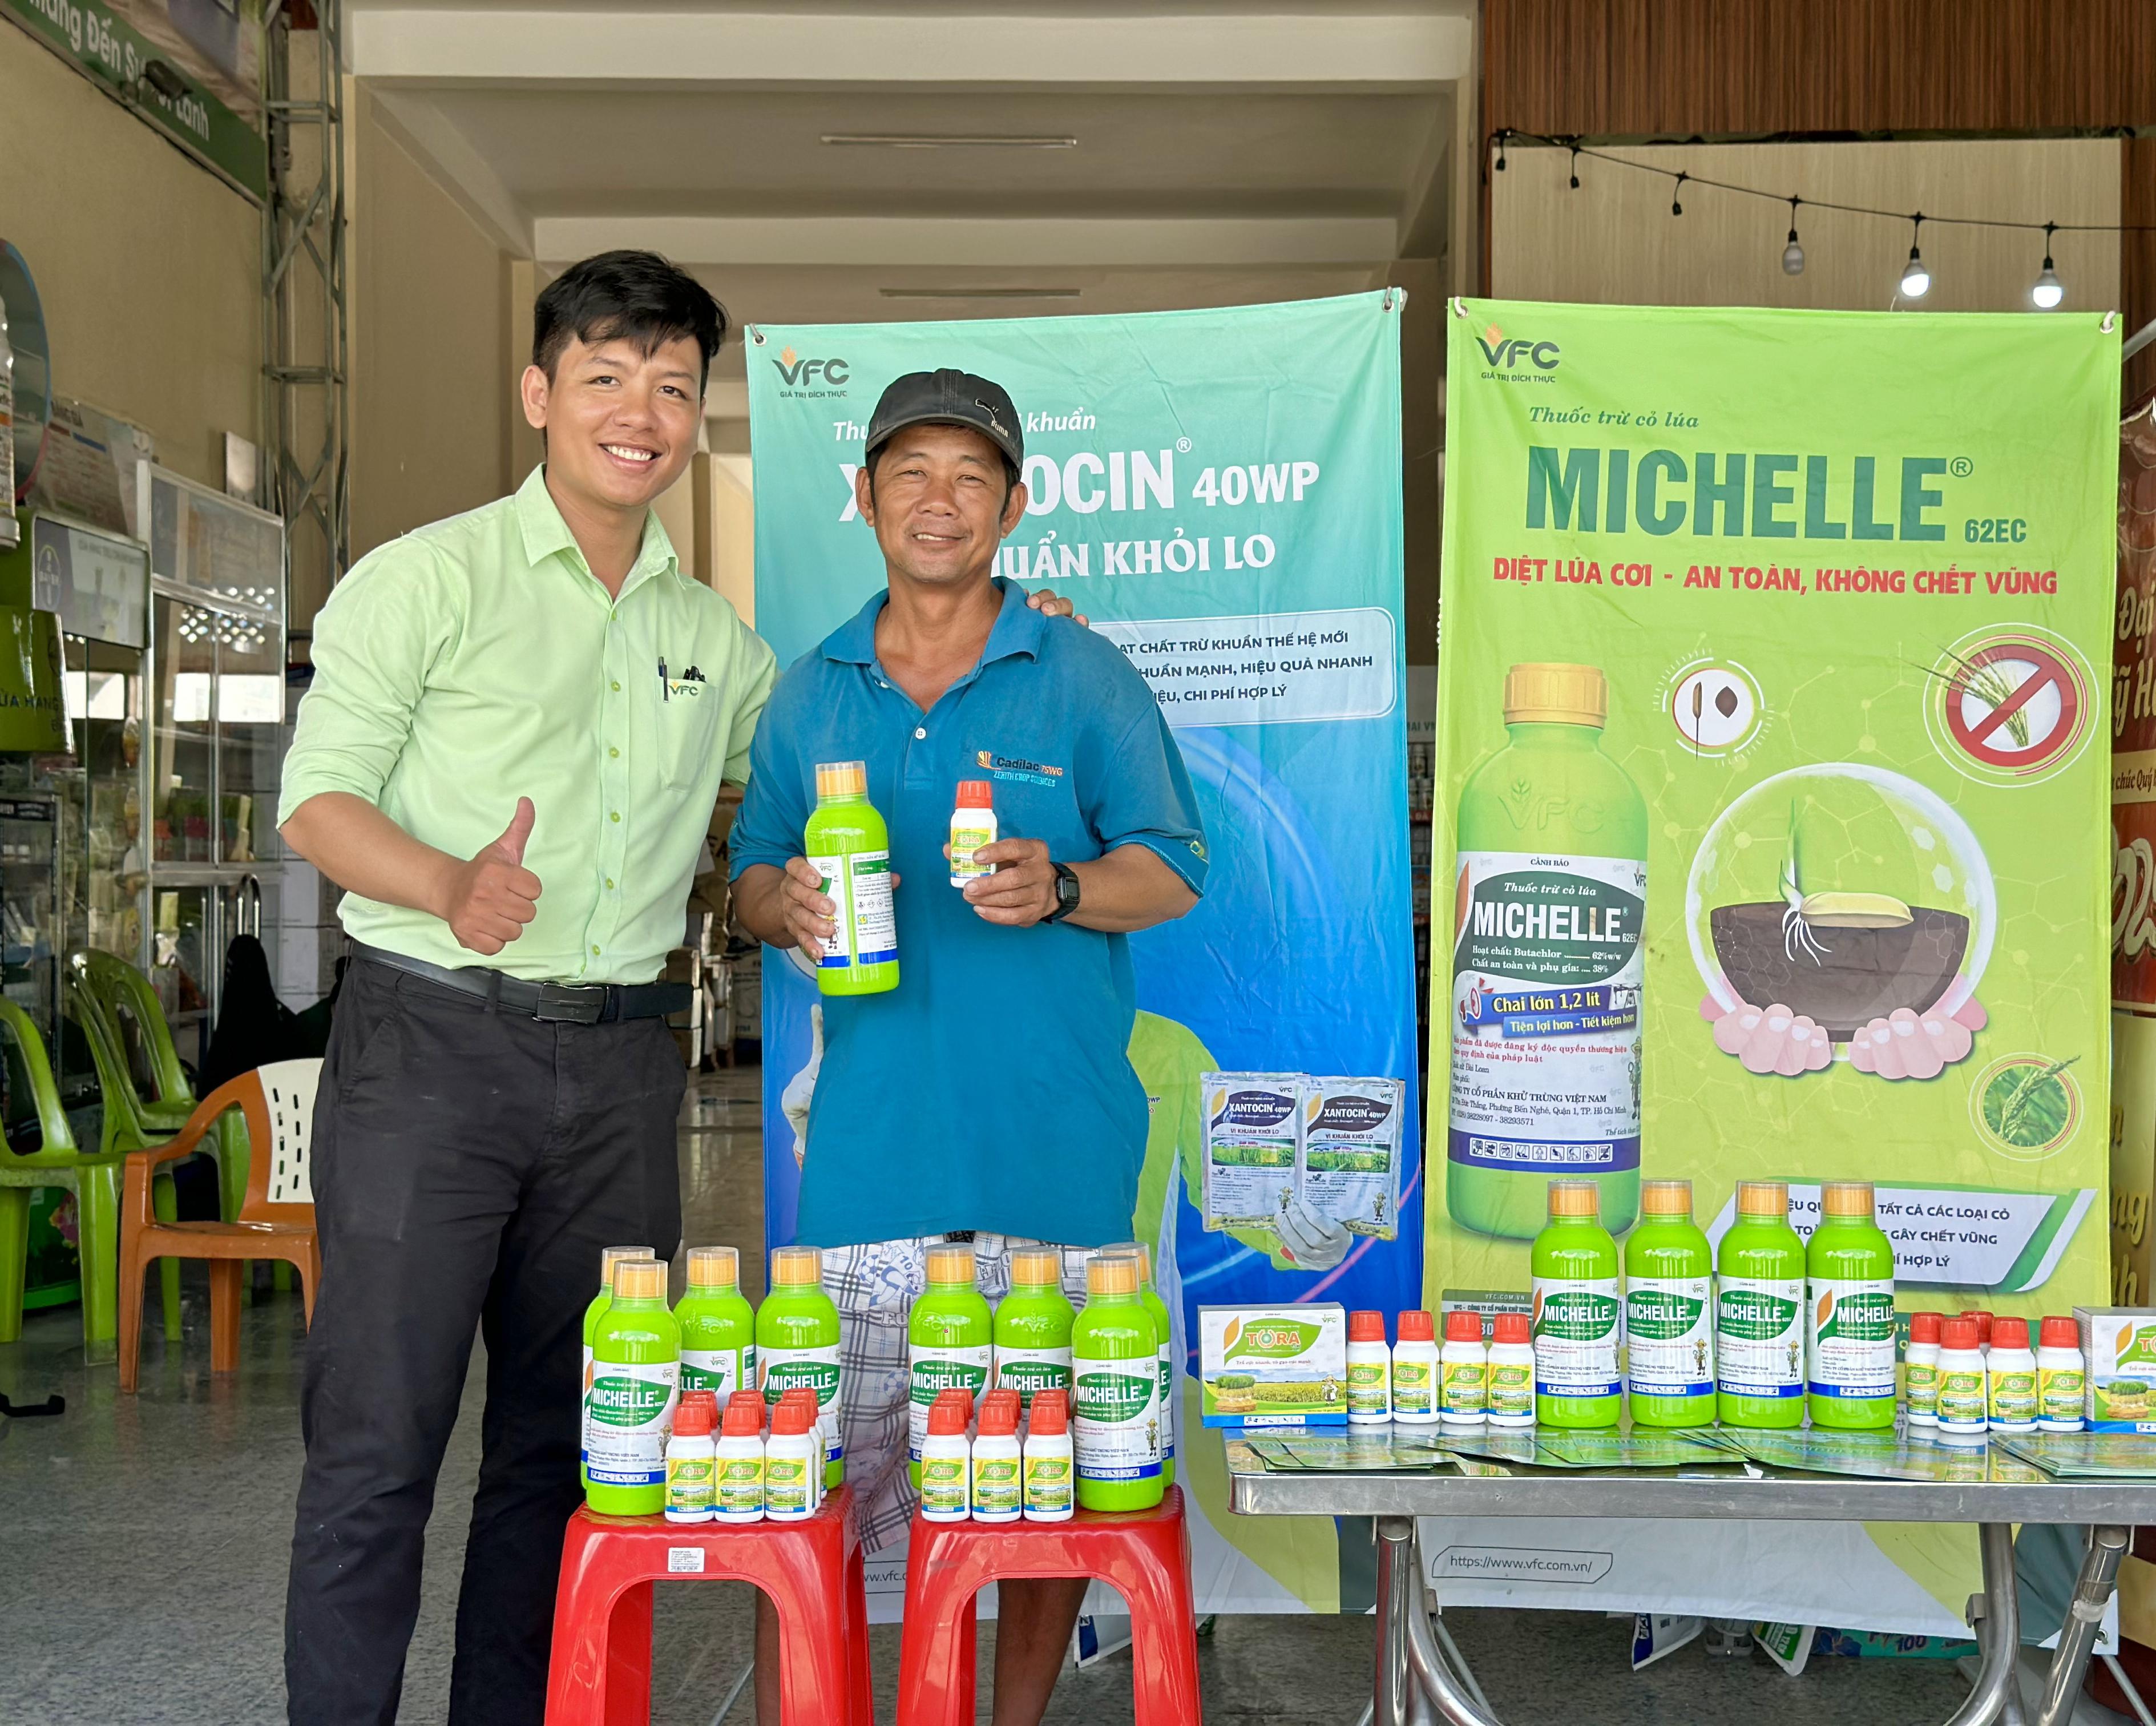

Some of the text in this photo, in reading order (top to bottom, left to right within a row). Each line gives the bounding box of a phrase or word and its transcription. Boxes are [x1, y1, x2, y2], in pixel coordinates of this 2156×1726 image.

[1475, 336, 1560, 370] VFC
[772, 359, 850, 386] VFC
[1497, 374, 1509, 382] TRỊ
[1511, 373, 1531, 382] ĐÍCH
[1533, 374, 1556, 384] THỰC
[827, 390, 847, 398] THỰC
[1026, 406, 1096, 433] khuẩn
[1529, 406, 1699, 428] Thuốc trừ cỏ lúa
[1192, 461, 1320, 507] 40WP
[1964, 518, 2027, 543] 62EC
[1103, 527, 1210, 576] KHỎI
[1224, 533, 1277, 570] LO
[1493, 554, 1548, 586] DIỆT
[1555, 557, 1603, 585] LÚA
[1683, 565, 1721, 589] AN
[1728, 563, 1807, 595] TOÀN,
[1815, 565, 1905, 594] KHÔNG
[1913, 563, 1976, 594] CHẾT
[1985, 566, 2057, 595] VŨNG
[1139, 630, 1348, 654] CHẤT TRỪ KHUẨN THẾ HỆ MỚI
[1138, 663, 1182, 678] HUẨN
[1186, 664, 1237, 678] MẠNH,
[1280, 657, 1314, 673] QUẢ
[1317, 655, 1372, 670] NHANH
[668, 685, 699, 696] VFC
[1184, 689, 1207, 701] CHI
[1210, 686, 1234, 700] PHÍ
[1238, 685, 1268, 701] HỢP
[1271, 684, 1287, 697] LÝ
[996, 757, 1040, 772] Cadilac
[1504, 882, 1597, 897] Thuốc trừ cỏ lúa
[1514, 947, 1562, 959] Butachlor
[1472, 958, 1488, 968] Chất
[1503, 960, 1523, 970] toàn
[1525, 961, 1537, 970] và
[1540, 962, 1559, 973] phụ
[1493, 995, 1525, 1013] Chai
[1530, 993, 1554, 1011] lớn
[1559, 993, 1582, 1011] 1,2
[1510, 1021, 1534, 1033] Tiện
[1536, 1020, 1551, 1031] lợi
[1552, 1020, 1573, 1031] hơn
[1581, 1016, 1600, 1029] Tiết
[1601, 1015, 1622, 1027] kiệm
[1484, 1041, 1503, 1050] được
[1527, 1043, 1538, 1052] ký
[1541, 1044, 1557, 1053] độc
[1502, 1052, 1523, 1063] pháp
[1525, 1054, 1543, 1063] luật
[1482, 1087, 1505, 1099] PHẦN
[1507, 1090, 1528, 1100] KHỬ
[1565, 1093, 1587, 1104] VIỆT
[1229, 1103, 1273, 1113] XANTOCIN
[1324, 1108, 1367, 1118] XANTOCIN
[1553, 1107, 1571, 1116] Quận
[1878, 1201, 1902, 1215] TẤT
[1905, 1204, 1923, 1216] CẢ
[1927, 1204, 1953, 1217] CÁC
[1957, 1208, 1988, 1221] LOẠI
[1991, 1208, 2010, 1220] CỎ
[1890, 1228, 1917, 1241] GÂY
[1920, 1228, 1956, 1242] CHẾT
[1959, 1231, 1998, 1245] VŨNG
[1903, 1255, 1933, 1268] HỢP
[1936, 1255, 1951, 1267] LÝ
[1450, 1555, 1592, 1573] https://www.vfc.com.vn/
